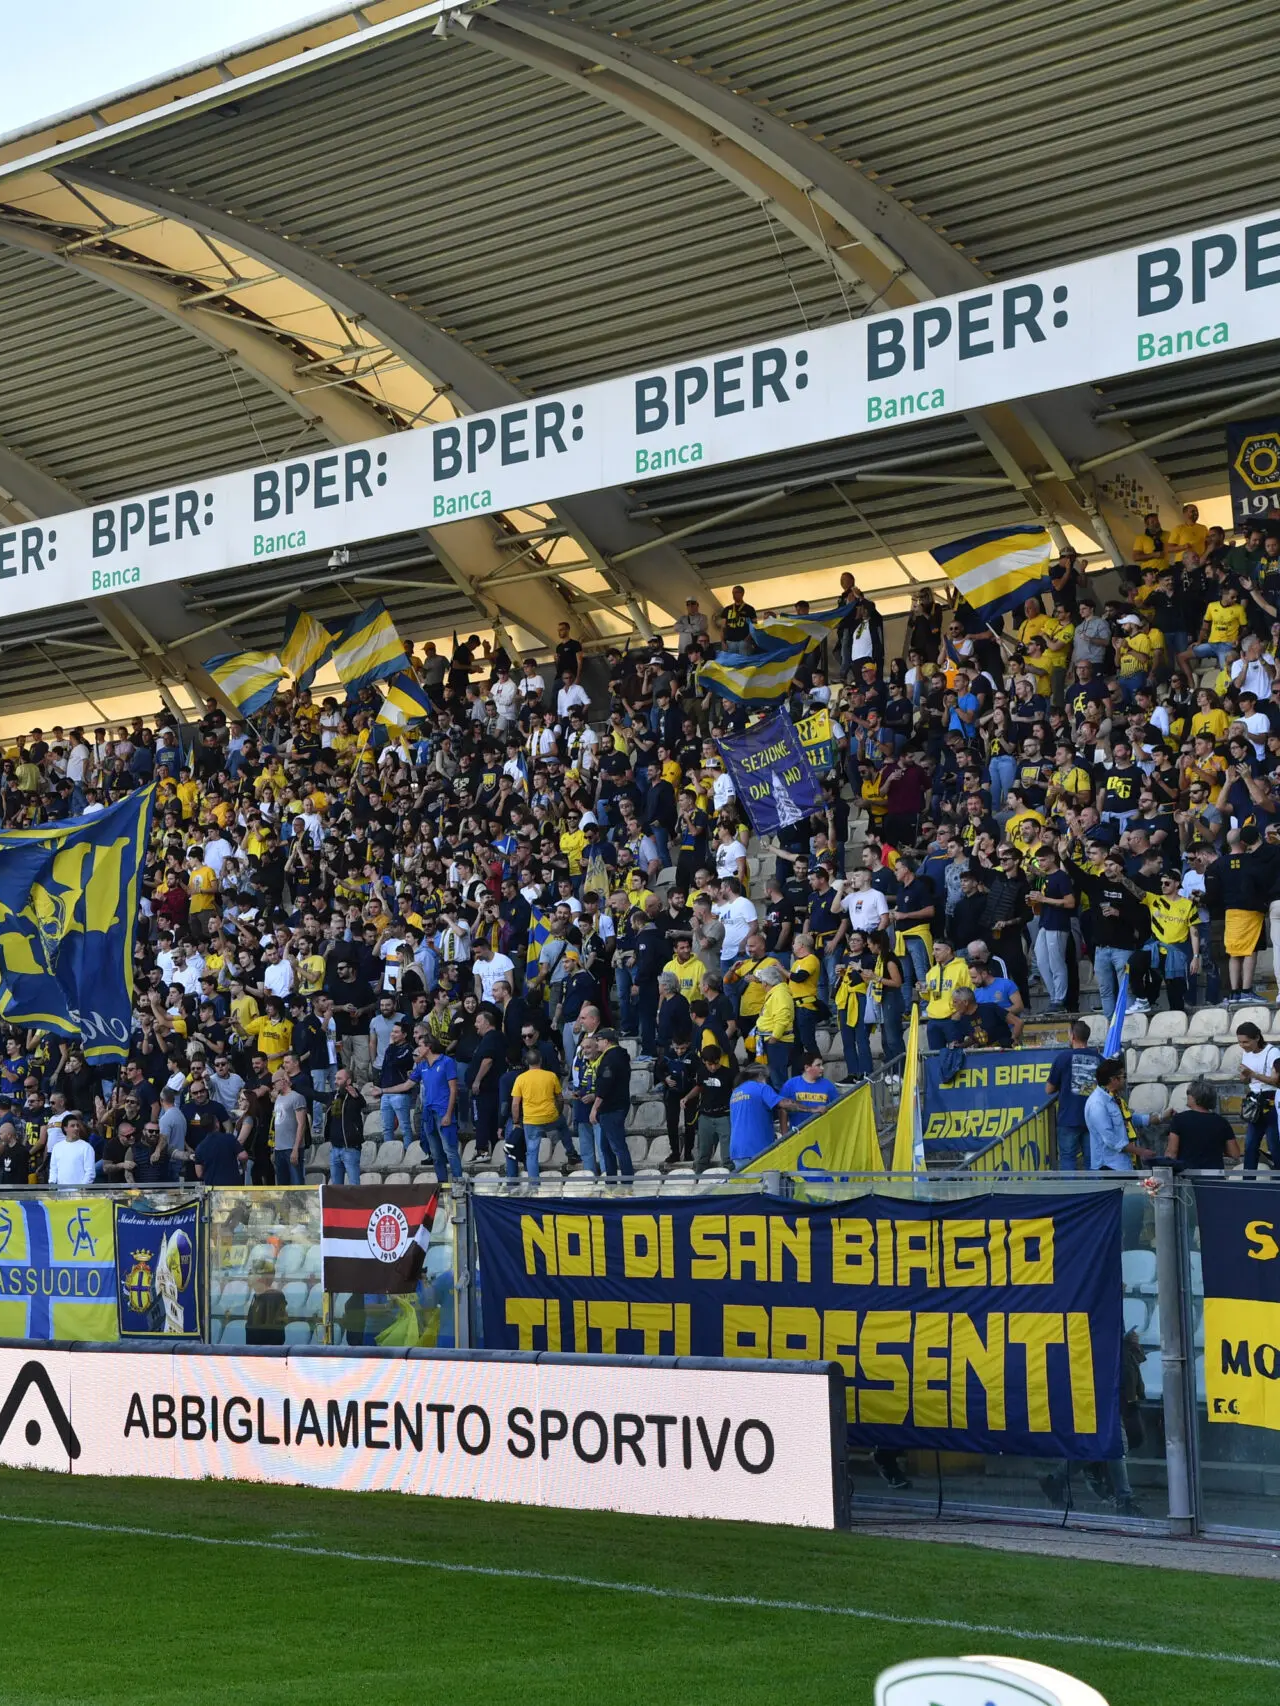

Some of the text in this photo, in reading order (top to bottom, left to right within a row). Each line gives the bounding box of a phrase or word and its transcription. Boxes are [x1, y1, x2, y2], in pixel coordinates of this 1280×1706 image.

[867, 283, 1069, 382] BPER:
[1137, 322, 1230, 361] Banca
[635, 347, 809, 435] BPER:
[867, 388, 945, 423] Banca
[432, 401, 584, 482] BPER:
[635, 441, 704, 473] Banca
[253, 448, 387, 522] BPER:
[433, 488, 492, 518] Banca
[92, 489, 214, 558] BPER:
[253, 529, 307, 556] Banca
[92, 567, 141, 591] Banca
[741, 740, 791, 773] SEZIONE
[995, 1063, 1052, 1086] BIAG
[369, 1221, 376, 1232] FC
[387, 1205, 407, 1231] PAULI
[380, 1251, 397, 1260] 1910
[520, 1214, 1054, 1289] NOI DI SAN BIAGIO
[123, 1391, 775, 1475] ABBIGLIAMENTO SPORTIVO
